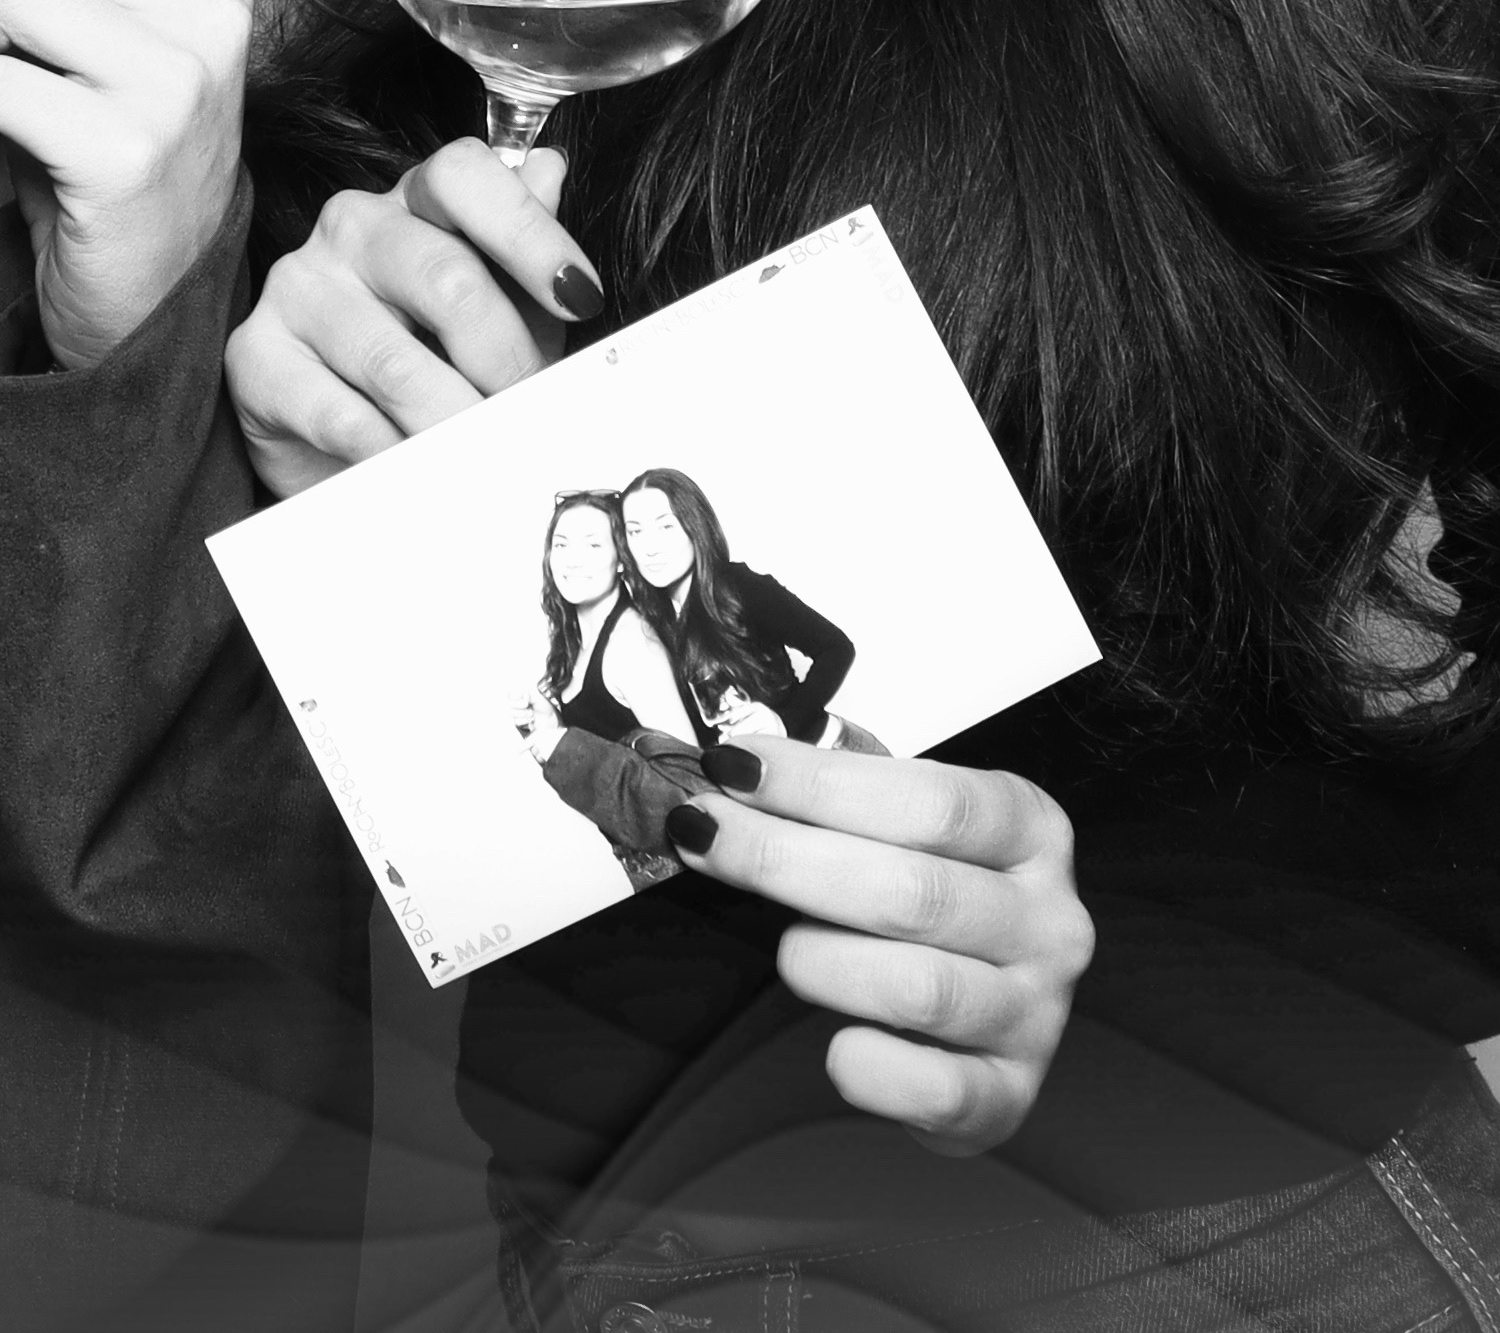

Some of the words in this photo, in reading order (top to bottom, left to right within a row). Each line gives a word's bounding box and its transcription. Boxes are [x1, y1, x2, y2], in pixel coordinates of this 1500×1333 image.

[788, 226, 840, 266] BCN
[394, 895, 434, 948] BCN
[454, 923, 512, 963] MAD
